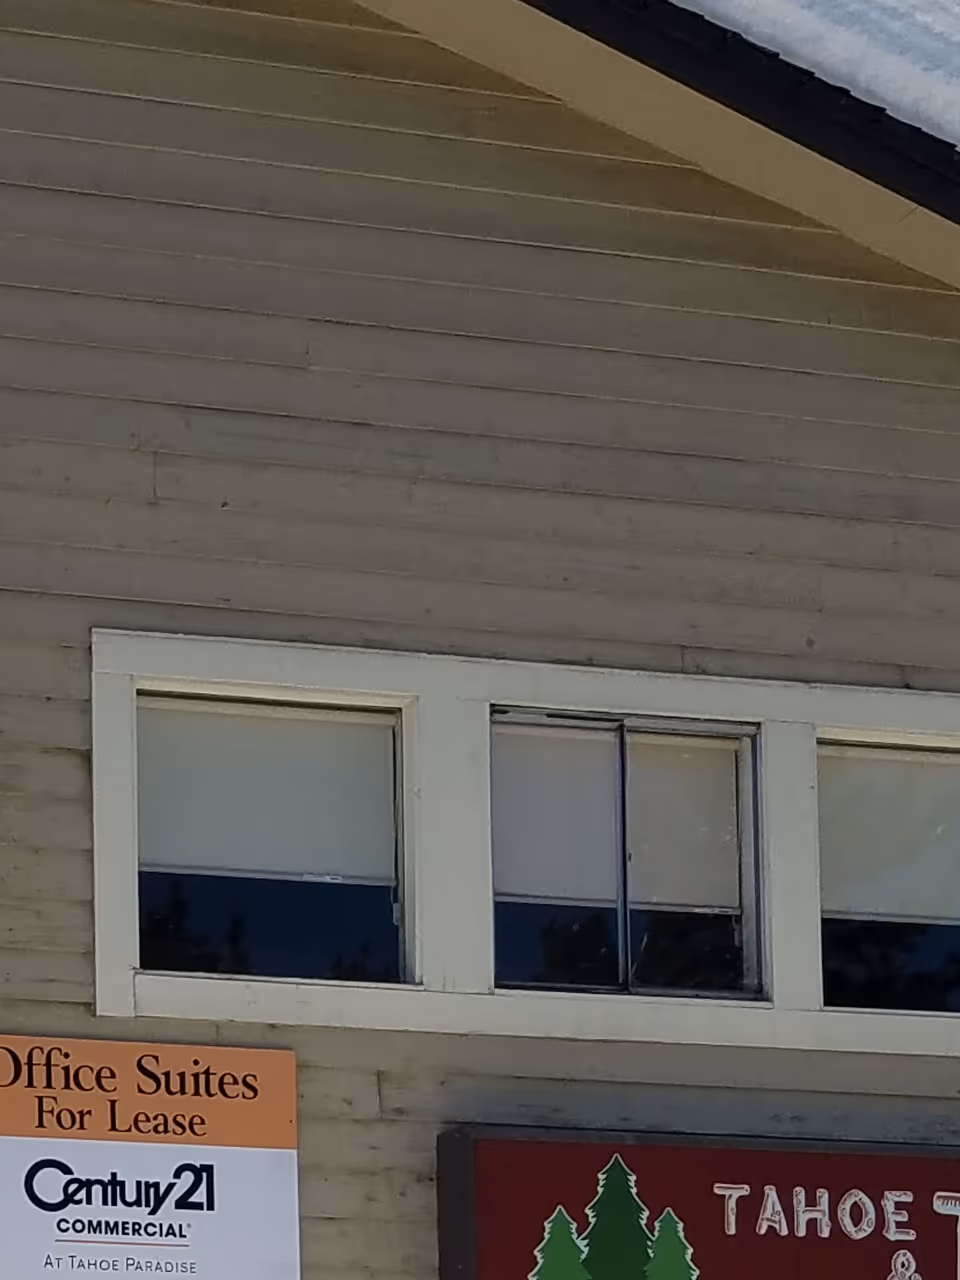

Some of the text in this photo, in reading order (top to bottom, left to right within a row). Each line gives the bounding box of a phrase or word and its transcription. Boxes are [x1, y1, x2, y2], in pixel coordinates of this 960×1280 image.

[136, 1053, 259, 1100] Suites
[34, 1095, 207, 1137] For Lease
[713, 1183, 917, 1241] TAHOE
